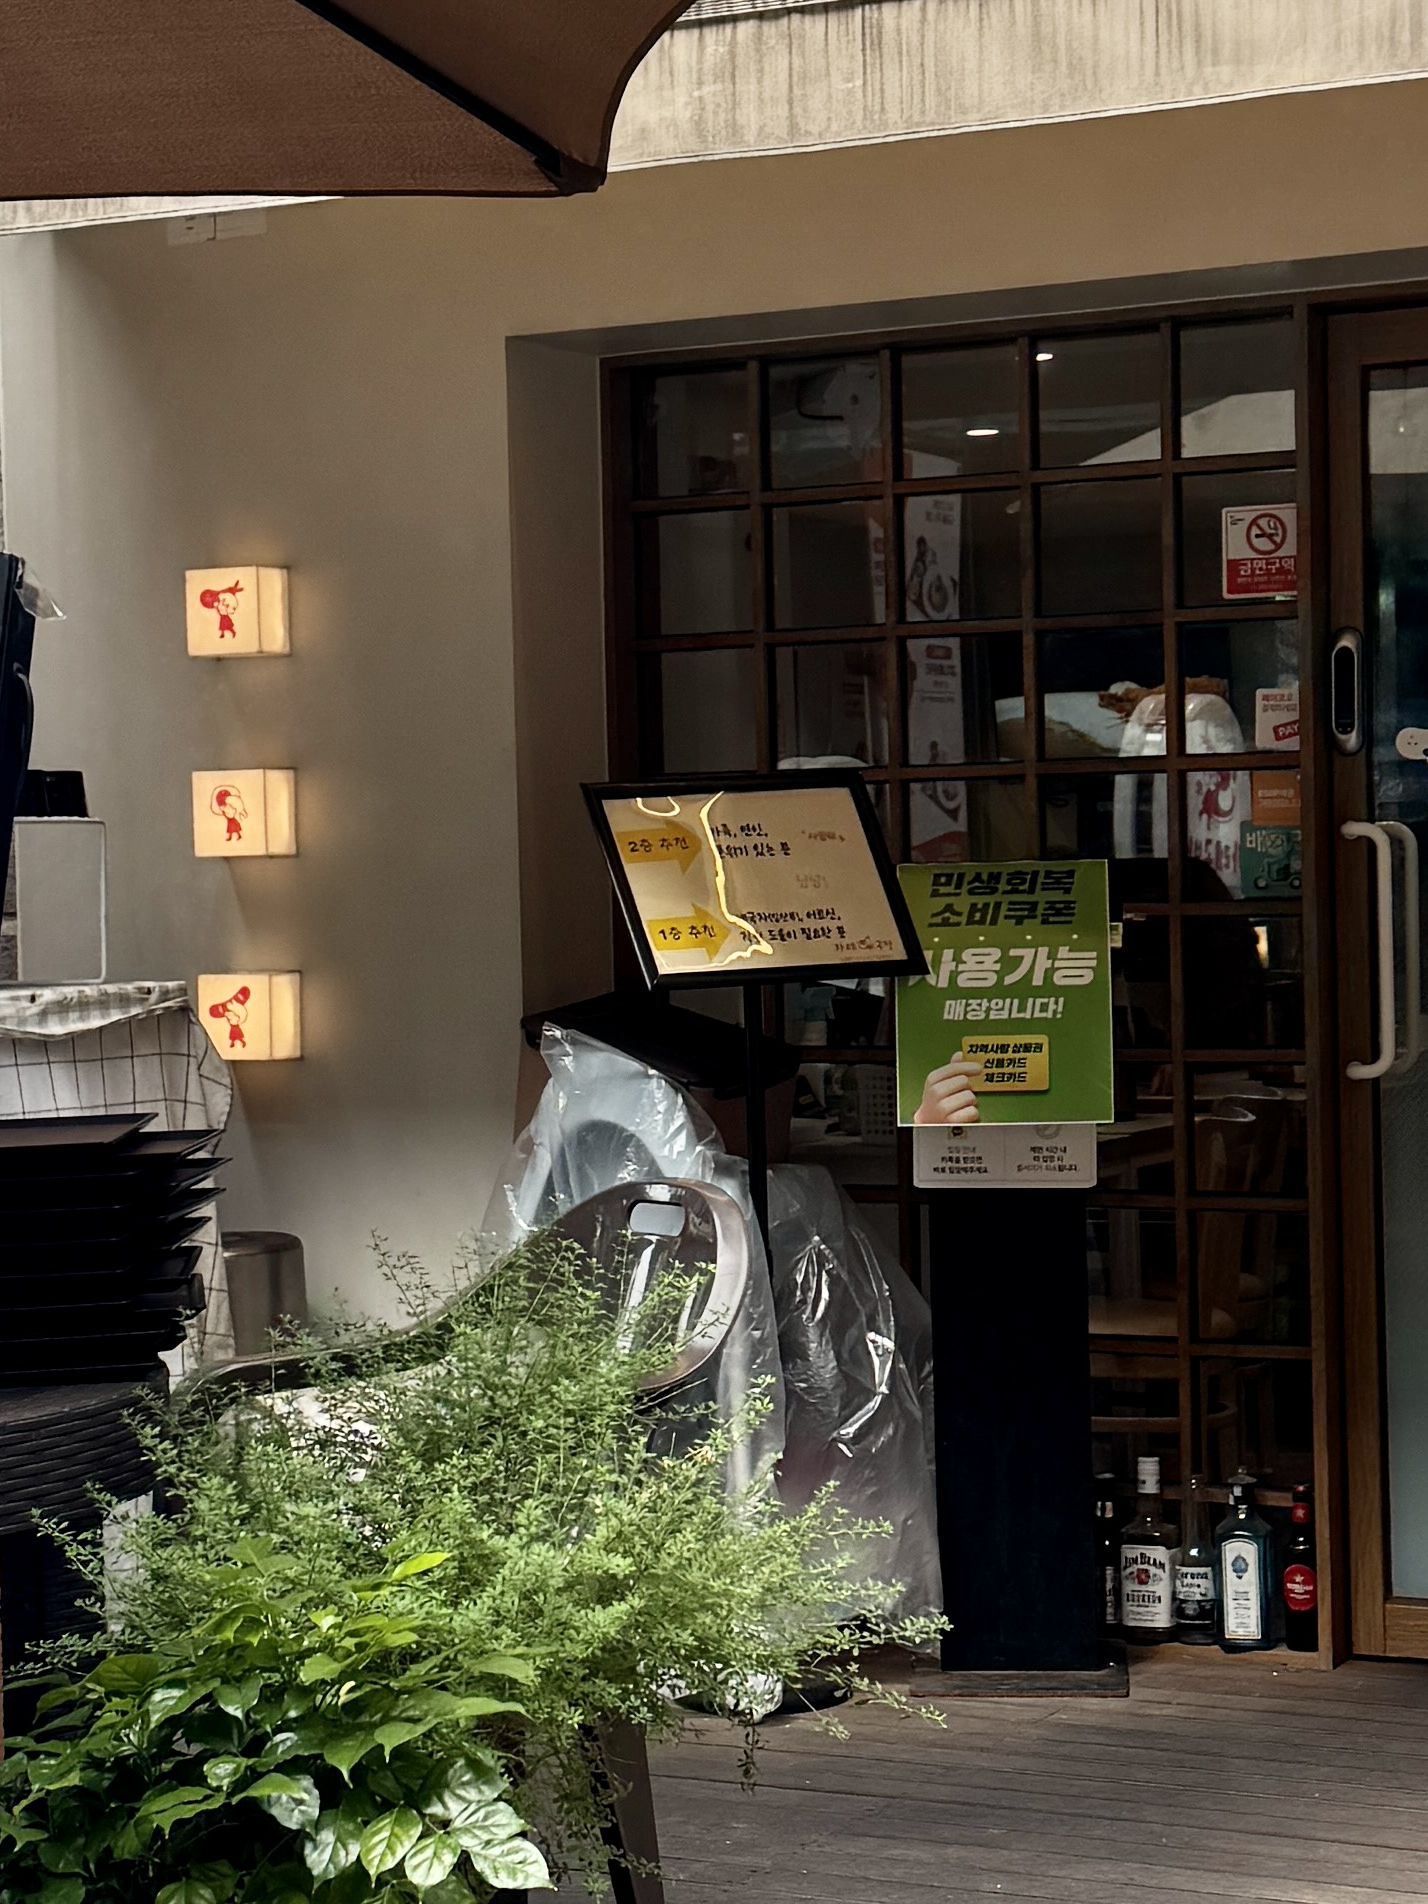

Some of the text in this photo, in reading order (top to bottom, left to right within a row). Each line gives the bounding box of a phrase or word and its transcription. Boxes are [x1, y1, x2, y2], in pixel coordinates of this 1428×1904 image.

[628, 839, 654, 853] 2층
[930, 868, 1076, 898] 민생회복
[927, 899, 1077, 928] 소비쿠폰
[658, 925, 683, 941] 1층
[908, 945, 1098, 989] 사용가능
[943, 997, 1065, 1021] 매장입니다!
